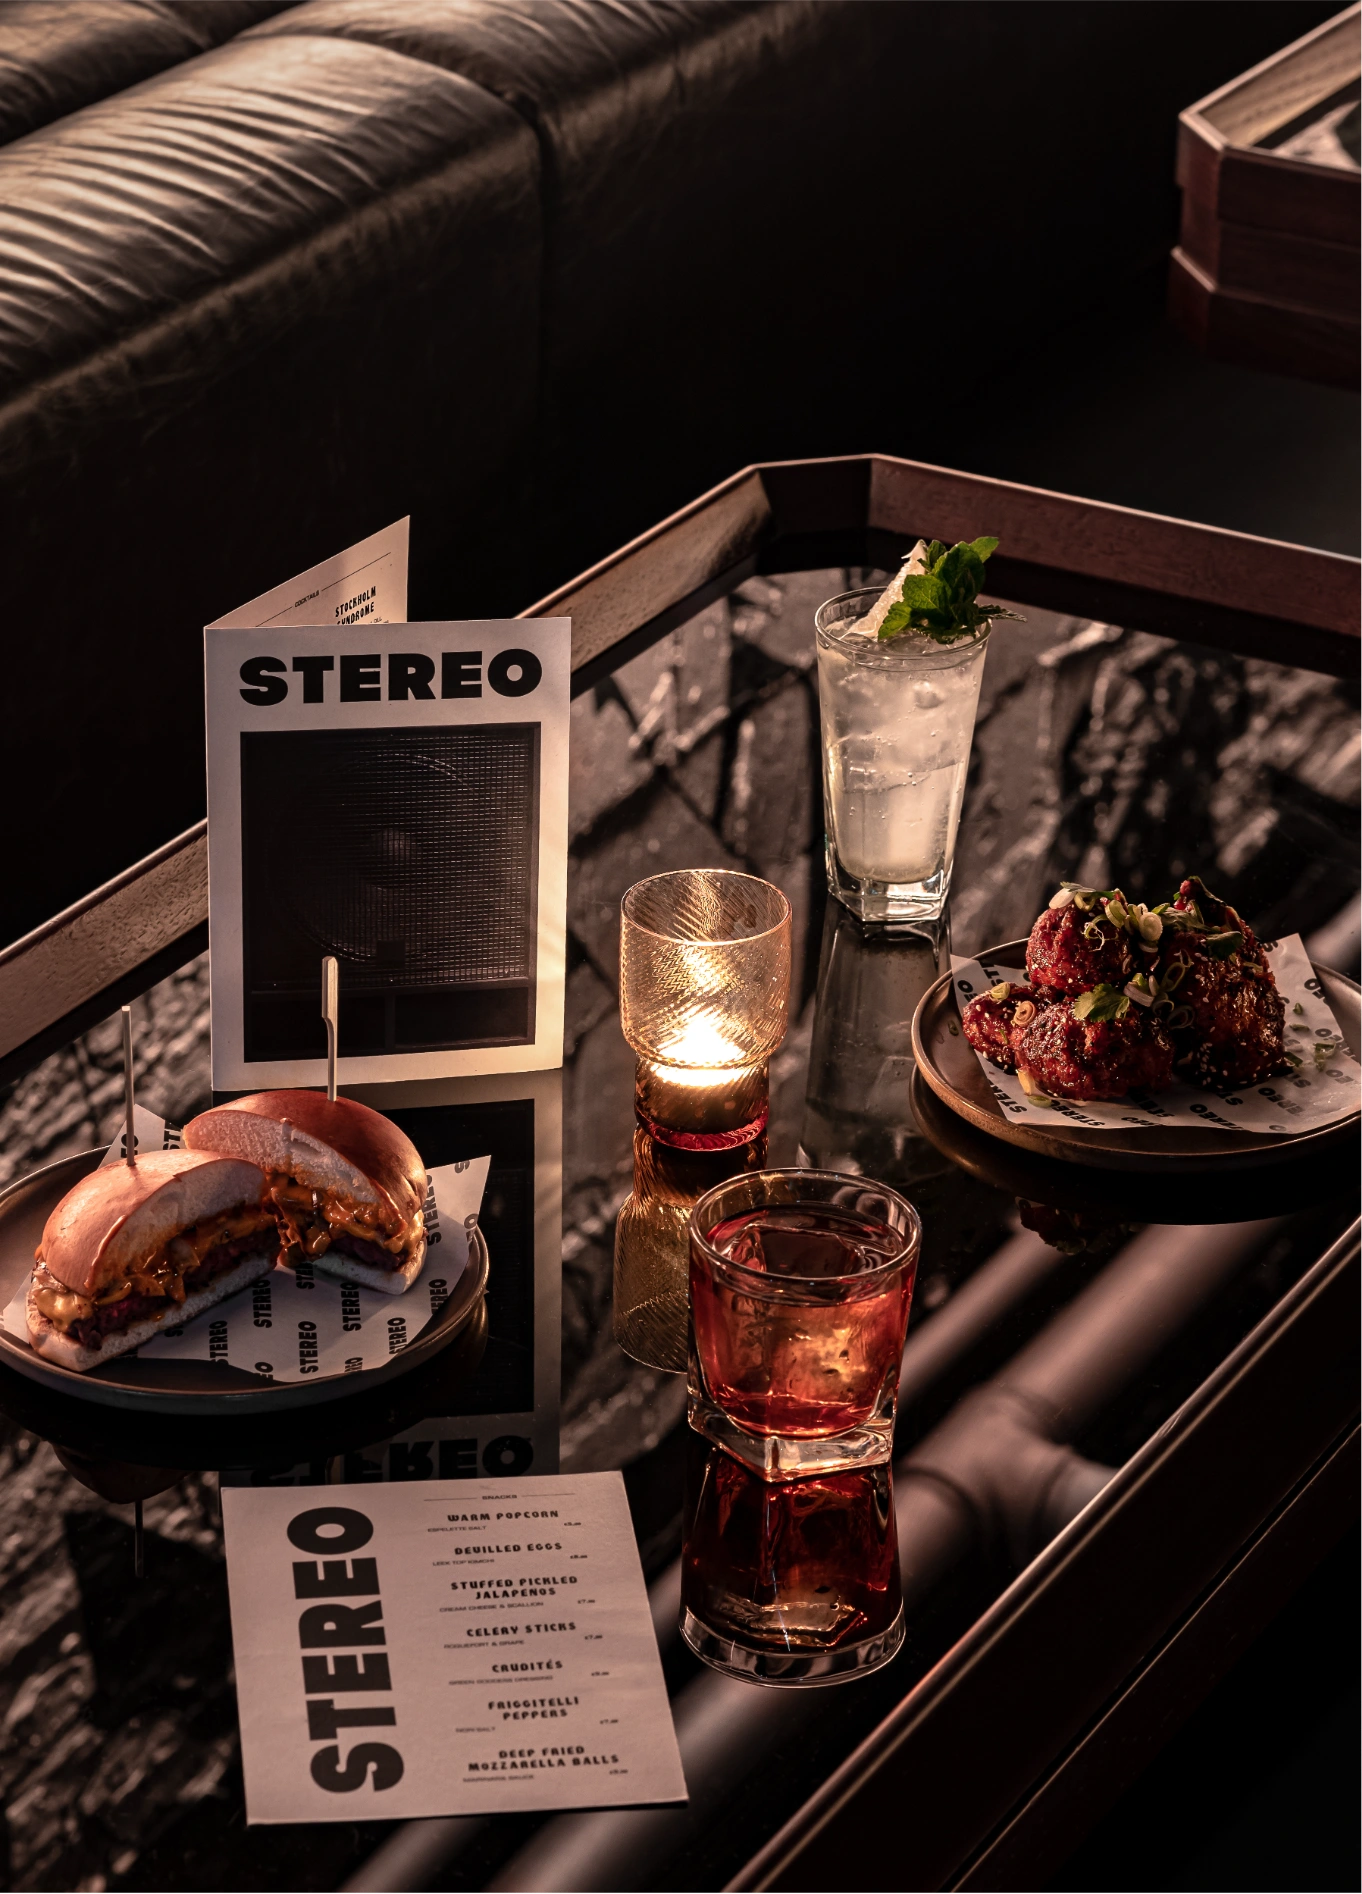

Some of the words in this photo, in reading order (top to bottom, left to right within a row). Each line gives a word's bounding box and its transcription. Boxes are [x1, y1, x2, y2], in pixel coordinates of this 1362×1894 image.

[294, 590, 320, 607] COCKTAILS
[335, 586, 376, 617] STOCKHOLM
[239, 649, 542, 706] STEREO
[253, 1280, 272, 1328] STEREO
[341, 1282, 362, 1332] STEREO
[298, 1321, 319, 1374] STEREO
[497, 1511, 558, 1519] POPCORN
[455, 1545, 520, 1554] DEVILLED
[527, 1543, 561, 1551] EGGS
[451, 1579, 513, 1590] STUFFED
[519, 1576, 578, 1587] PICKLED
[507, 1601, 544, 1609] SCALLION
[467, 1626, 518, 1636] CELERY
[526, 1623, 575, 1633] STICKS
[287, 1507, 404, 1793] STEREO
[444, 1641, 489, 1649] ROQUEFORT
[492, 1659, 562, 1672] CRUDITÉS
[488, 1696, 579, 1710] FRIGGITELLI
[503, 1709, 568, 1720] PEPPERS
[499, 1749, 535, 1758] DEEP
[542, 1746, 585, 1757] FRIED
[468, 1759, 566, 1771] MOZZARELLA
[572, 1755, 619, 1766] BALLS
